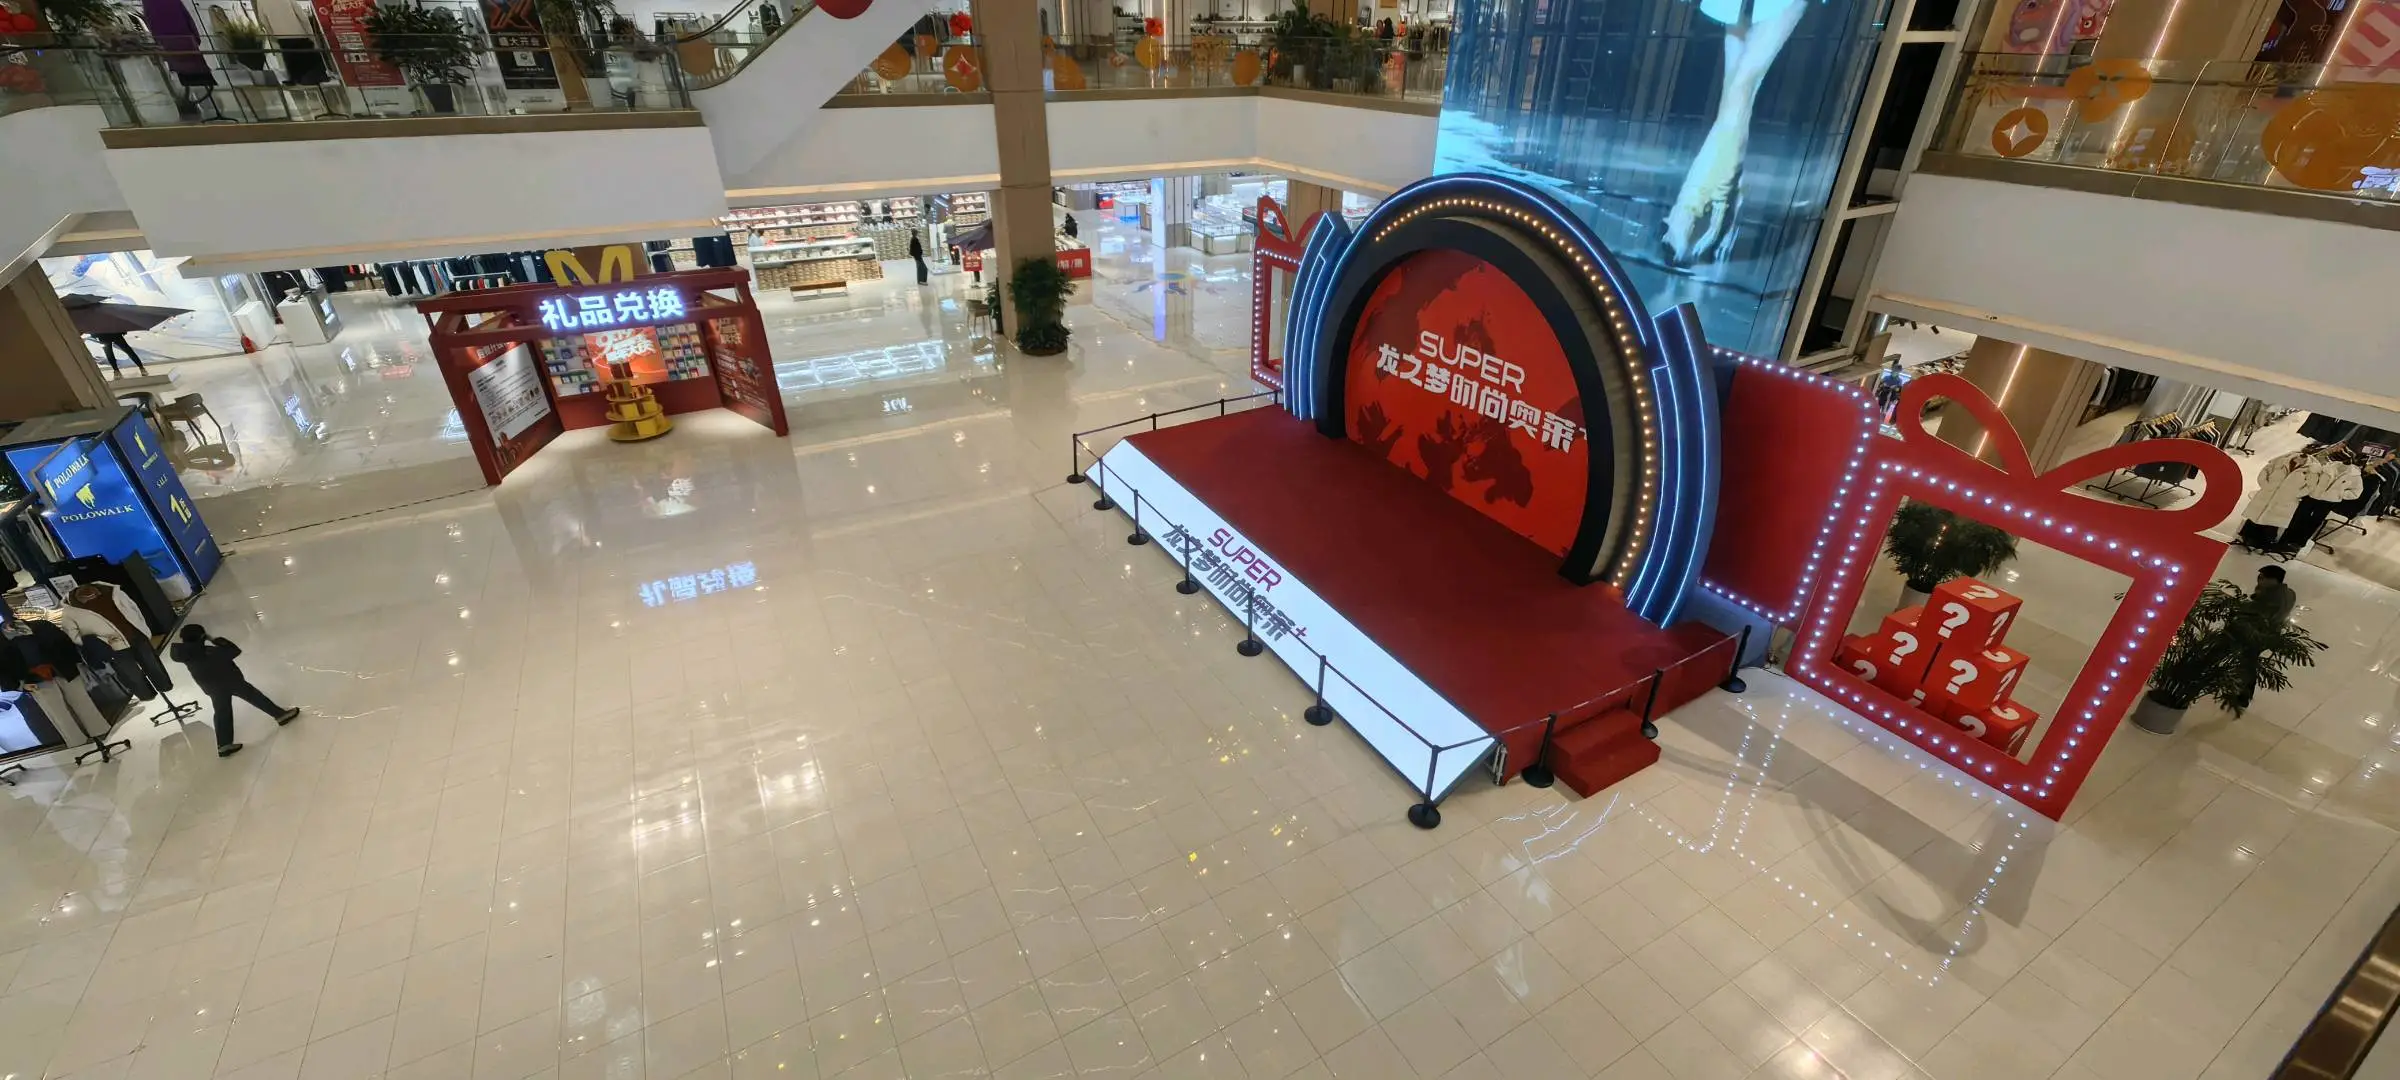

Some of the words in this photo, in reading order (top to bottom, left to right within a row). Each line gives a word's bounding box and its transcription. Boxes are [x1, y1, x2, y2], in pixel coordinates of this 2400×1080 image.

[538, 287, 685, 330] 礼品兑换
[1419, 330, 1526, 394] SUPER
[53, 453, 90, 489] POLOWALK
[61, 504, 135, 523] POLOWALK
[1207, 528, 1282, 592] SUPER
